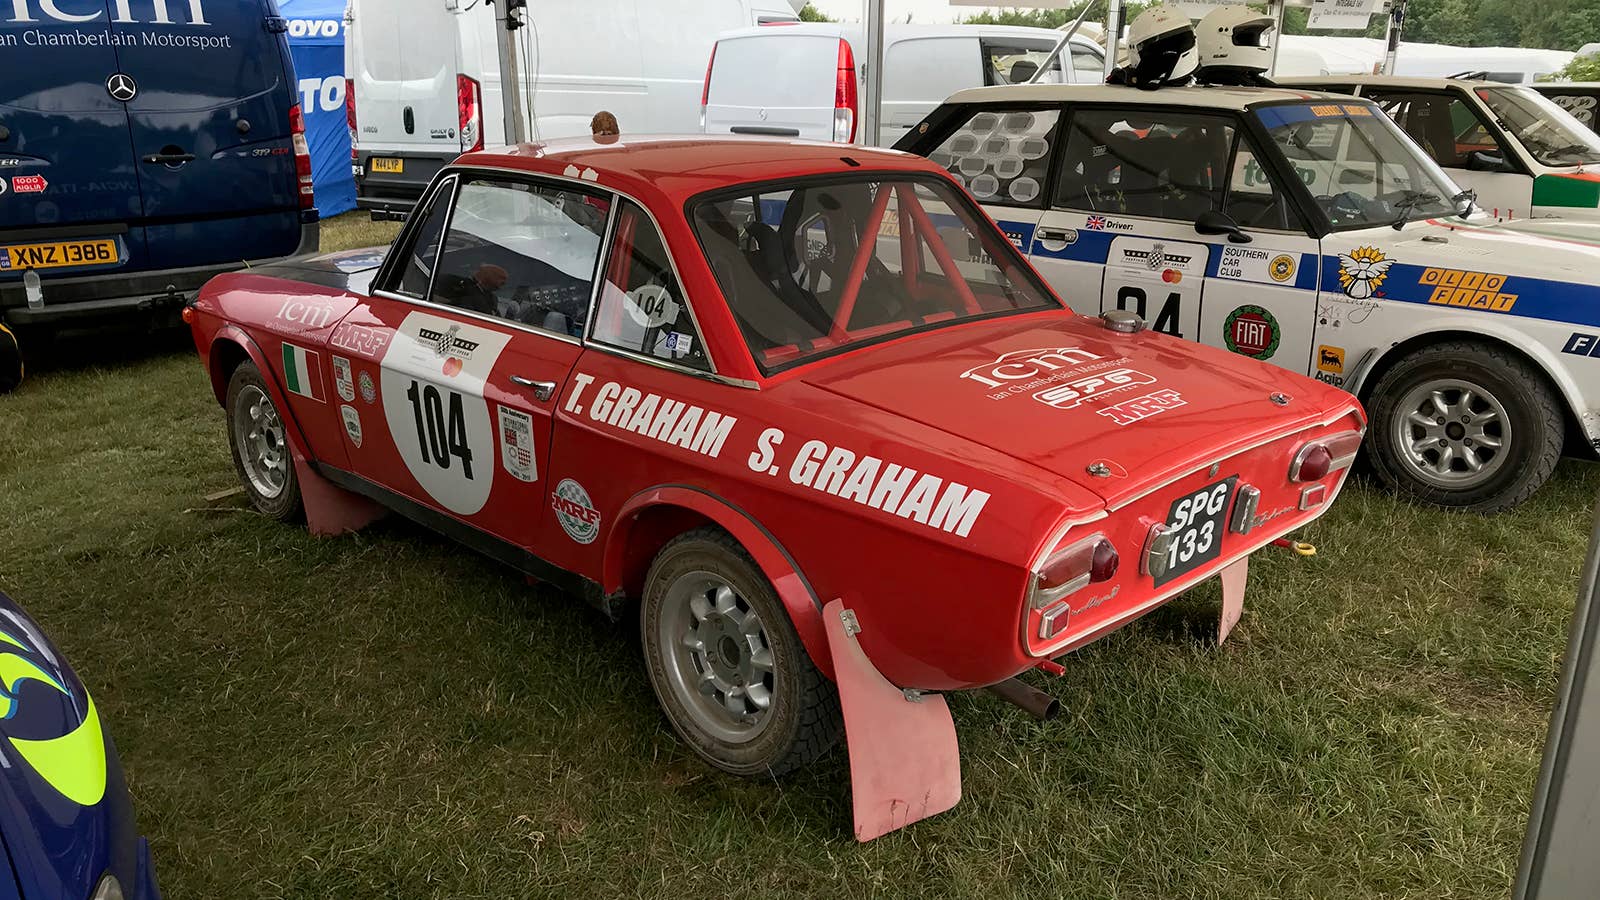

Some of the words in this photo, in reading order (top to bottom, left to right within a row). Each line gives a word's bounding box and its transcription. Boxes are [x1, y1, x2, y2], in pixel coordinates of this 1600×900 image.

[0, 34, 17, 46] an
[23, 29, 136, 46] Chamberlain
[143, 31, 232, 49] Motorsport
[286, 19, 339, 37] OYO
[1106, 220, 1134, 231] Driver:
[14, 247, 58, 265] XNZ
[64, 243, 110, 262] 1386
[1223, 258, 1240, 266] CAR
[1225, 248, 1269, 259] SOUTHERN
[1220, 268, 1242, 277] CLUB
[1425, 270, 1500, 289] OLIO
[636, 293, 667, 318] 104
[1436, 289, 1512, 309] FIAT
[331, 322, 390, 356] MRF
[1236, 320, 1267, 347] FIAT
[1008, 369, 1079, 394] Chamberlain
[1042, 369, 1134, 405] SPG
[1315, 370, 1344, 388] Agip
[1096, 388, 1188, 426] MRF
[407, 380, 474, 481] 104
[564, 372, 595, 415] T.
[589, 381, 738, 458] GRAHAM
[748, 427, 785, 477] S.
[788, 439, 992, 538] GRAHAM
[551, 491, 602, 525] MRF
[1173, 483, 1228, 533] SPG
[1169, 519, 1215, 570] 133
